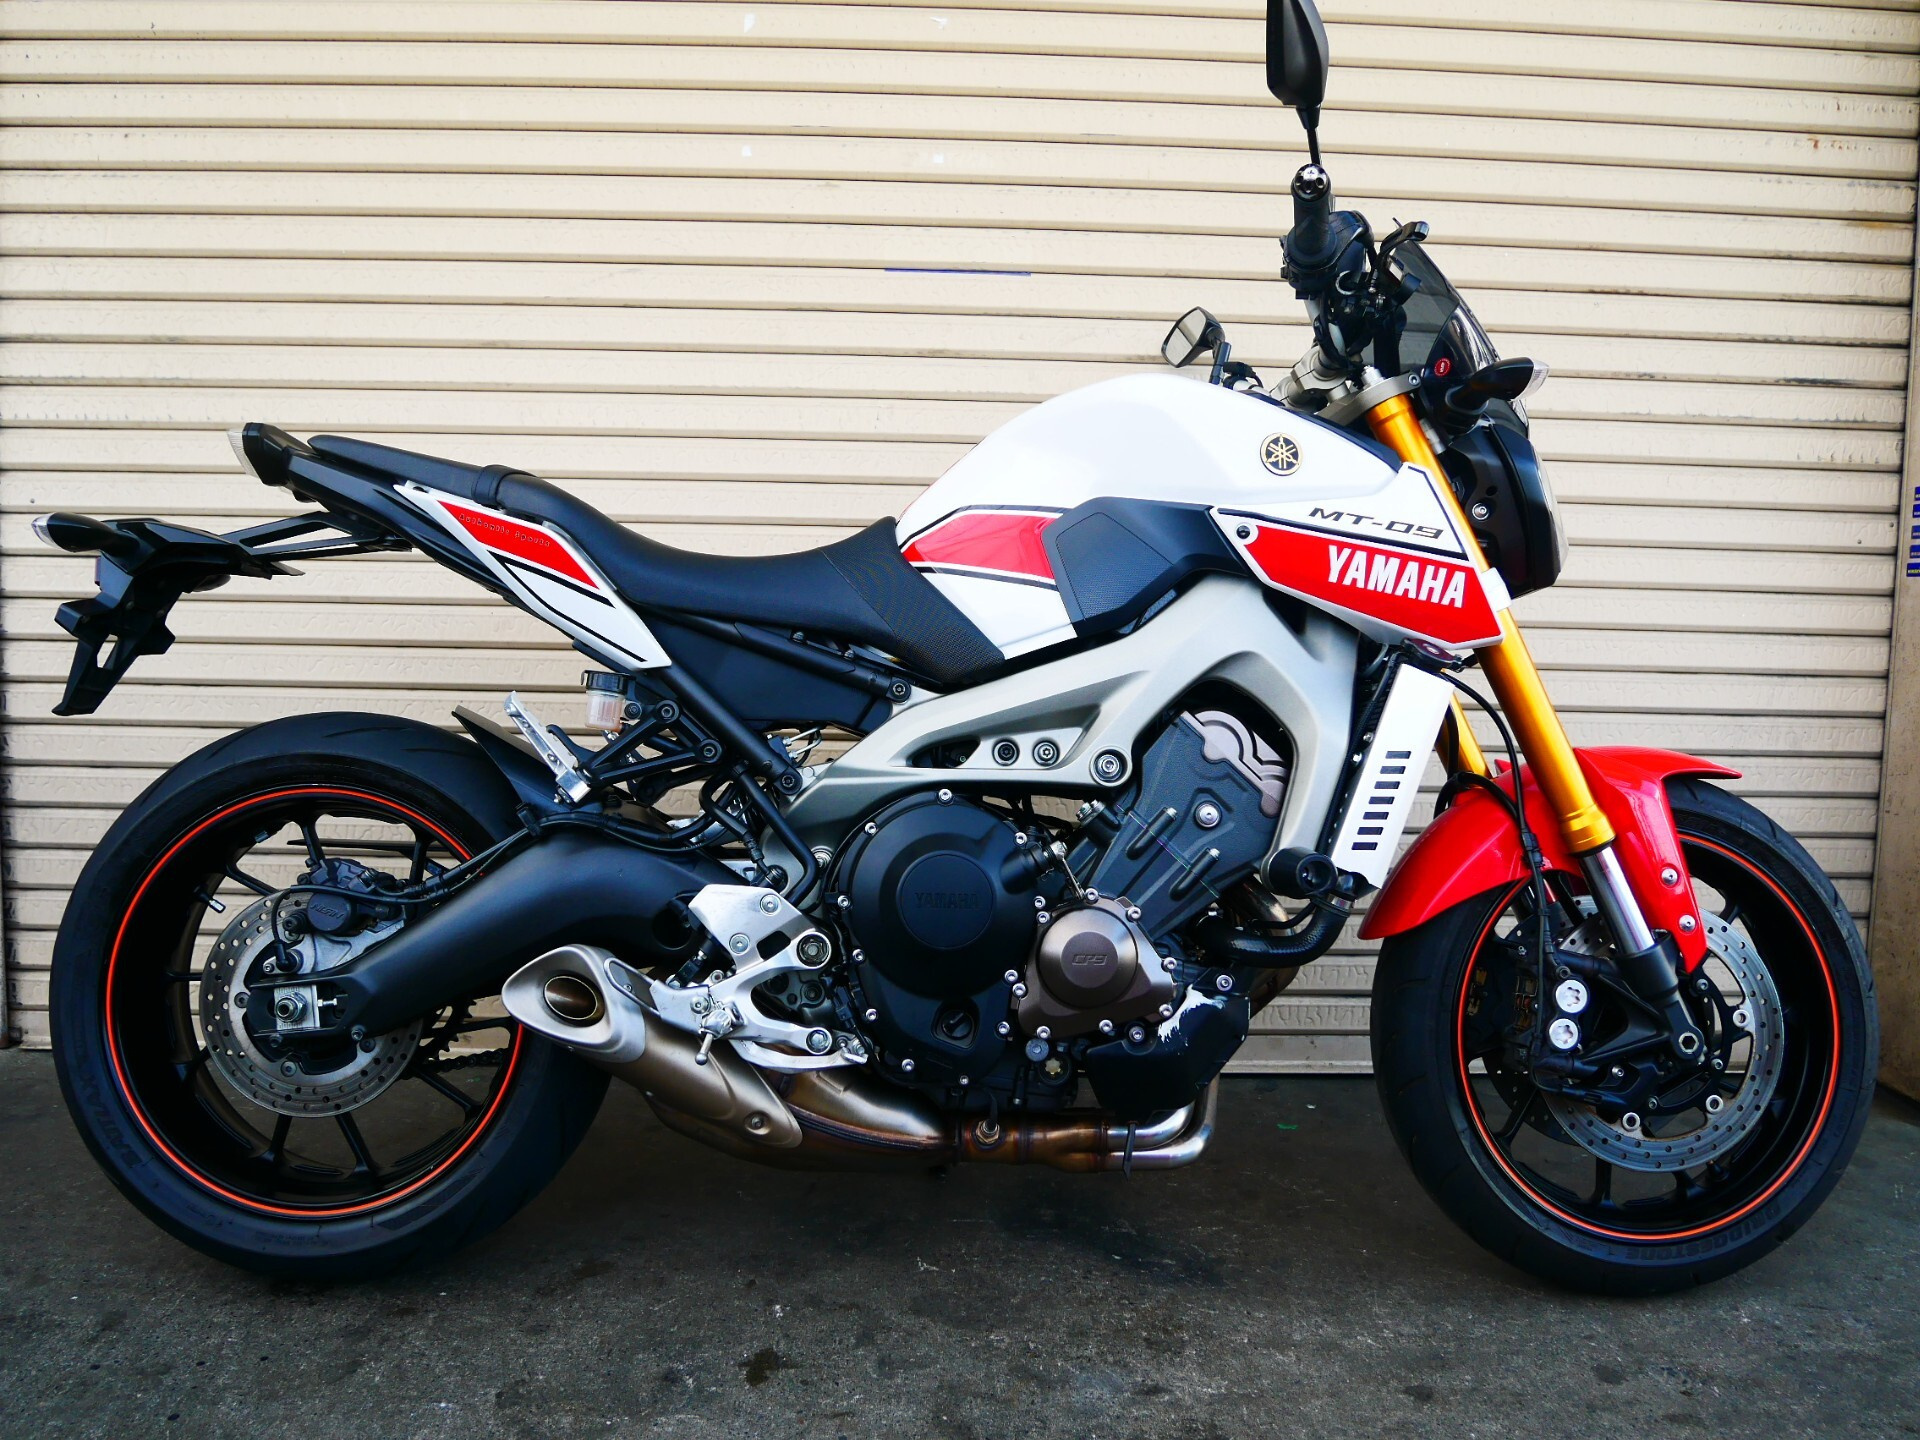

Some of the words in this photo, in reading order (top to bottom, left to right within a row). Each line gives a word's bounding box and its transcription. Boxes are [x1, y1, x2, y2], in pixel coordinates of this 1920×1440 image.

[1309, 508, 1444, 539] MT-09
[1328, 545, 1466, 608] YAMAHA
[914, 892, 980, 910] YAMAHA
